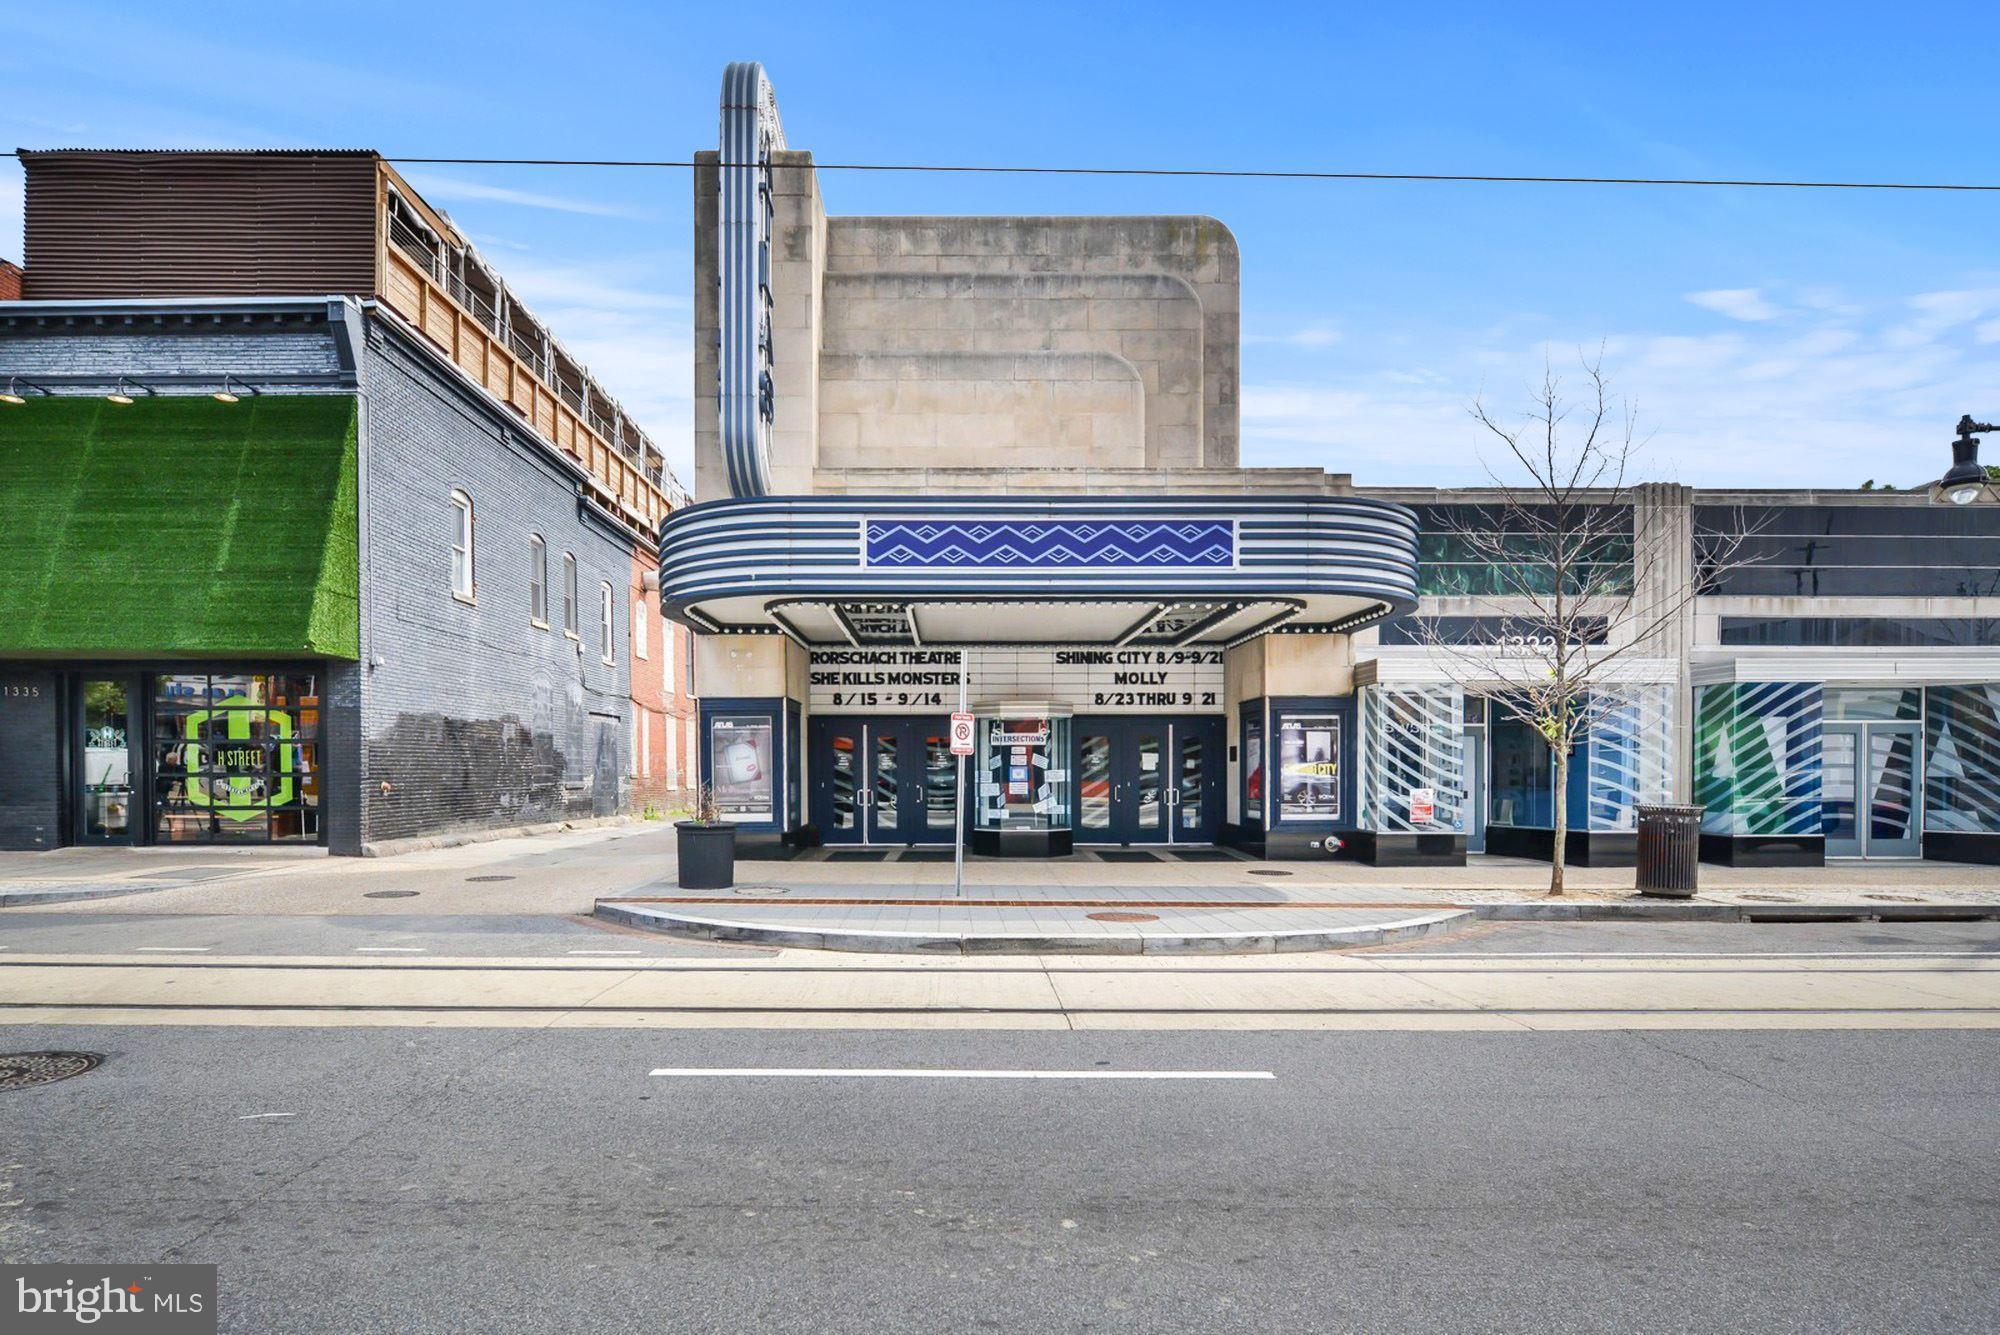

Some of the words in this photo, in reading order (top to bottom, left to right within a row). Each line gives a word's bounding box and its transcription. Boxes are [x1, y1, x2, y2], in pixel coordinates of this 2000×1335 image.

[811, 652, 896, 664] RORSCHACH
[900, 652, 961, 664] THEATRE
[1056, 652, 1112, 664] SHINING
[1117, 652, 1151, 664] CITY
[811, 672, 839, 685] SHE
[843, 672, 885, 685] KILLS
[1115, 672, 1168, 684] MOLLY
[4, 686, 39, 697] 1335
[833, 693, 877, 705] 8/15
[898, 693, 941, 705] 9/14
[1095, 693, 1134, 705] 8/23
[1137, 693, 1175, 705] THRU
[218, 750, 225, 766] H
[227, 750, 261, 766] STREET
